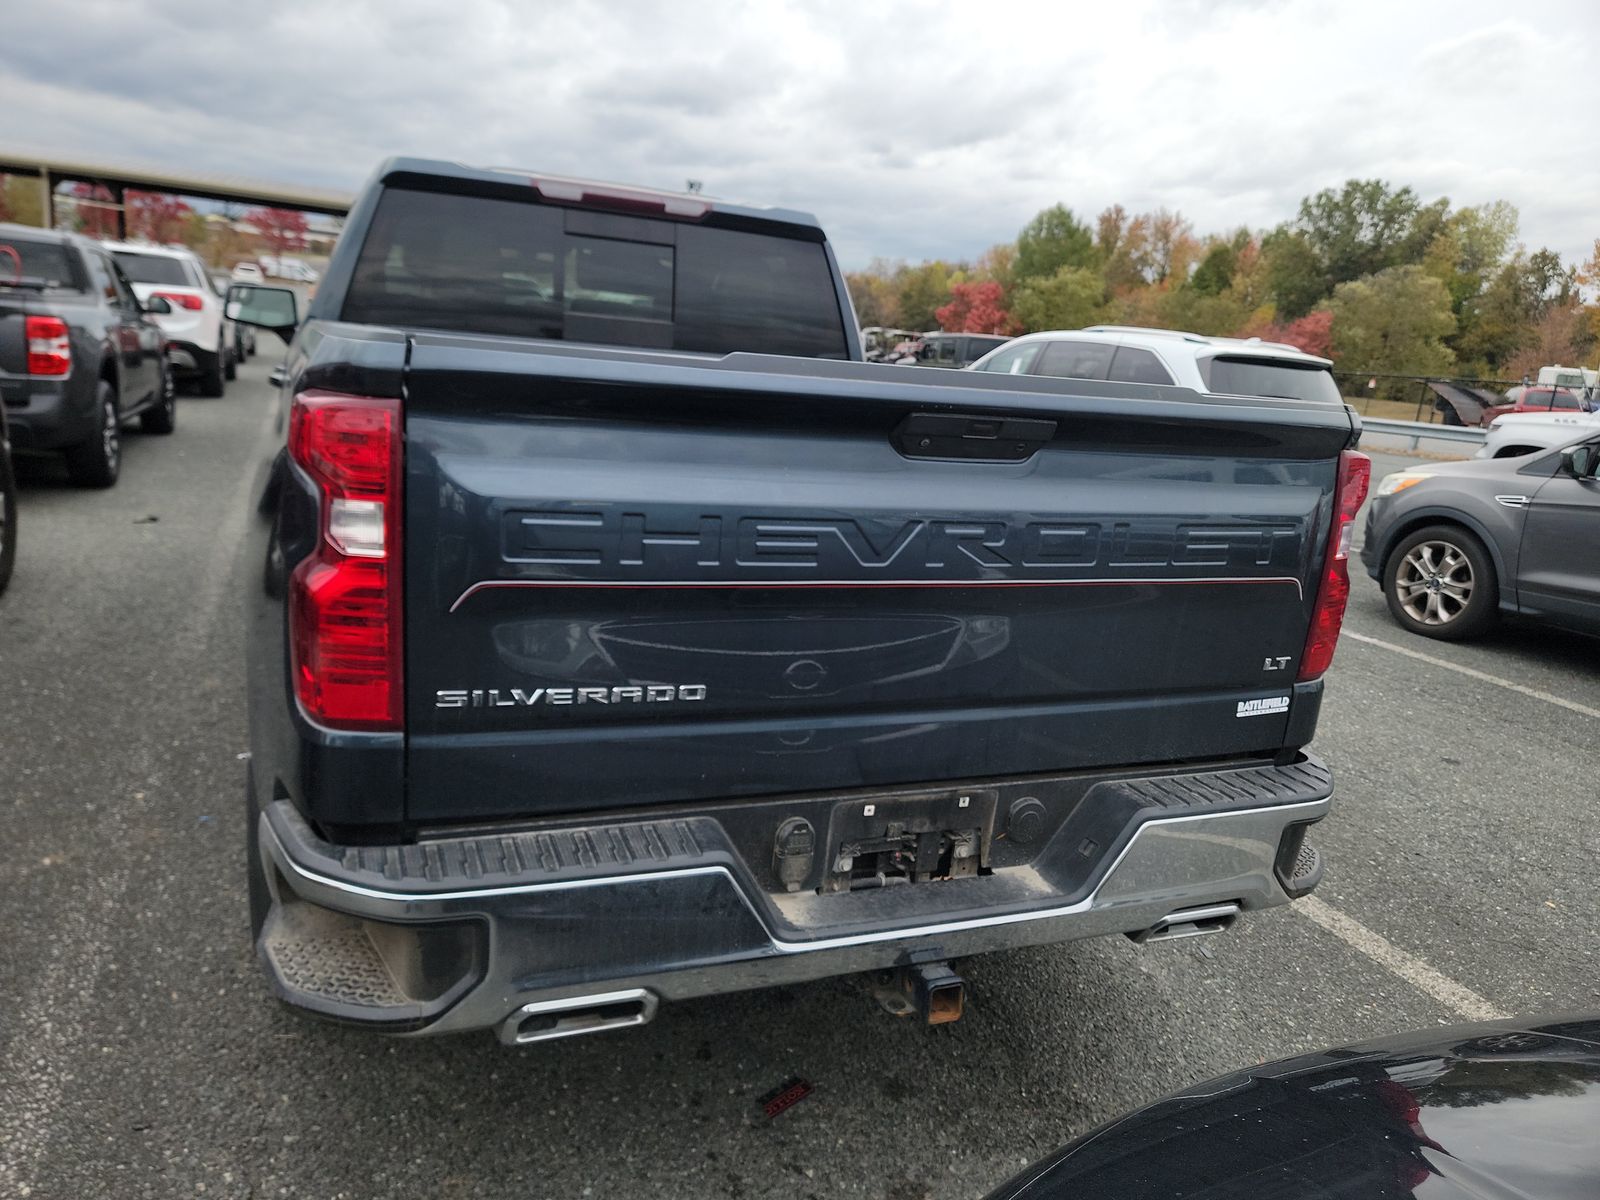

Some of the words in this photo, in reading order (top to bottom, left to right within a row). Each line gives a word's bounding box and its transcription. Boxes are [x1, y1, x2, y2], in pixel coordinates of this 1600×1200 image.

[502, 508, 1298, 567] CHEVROLET
[1263, 656, 1292, 671] LT
[434, 684, 707, 708] SILVERADO
